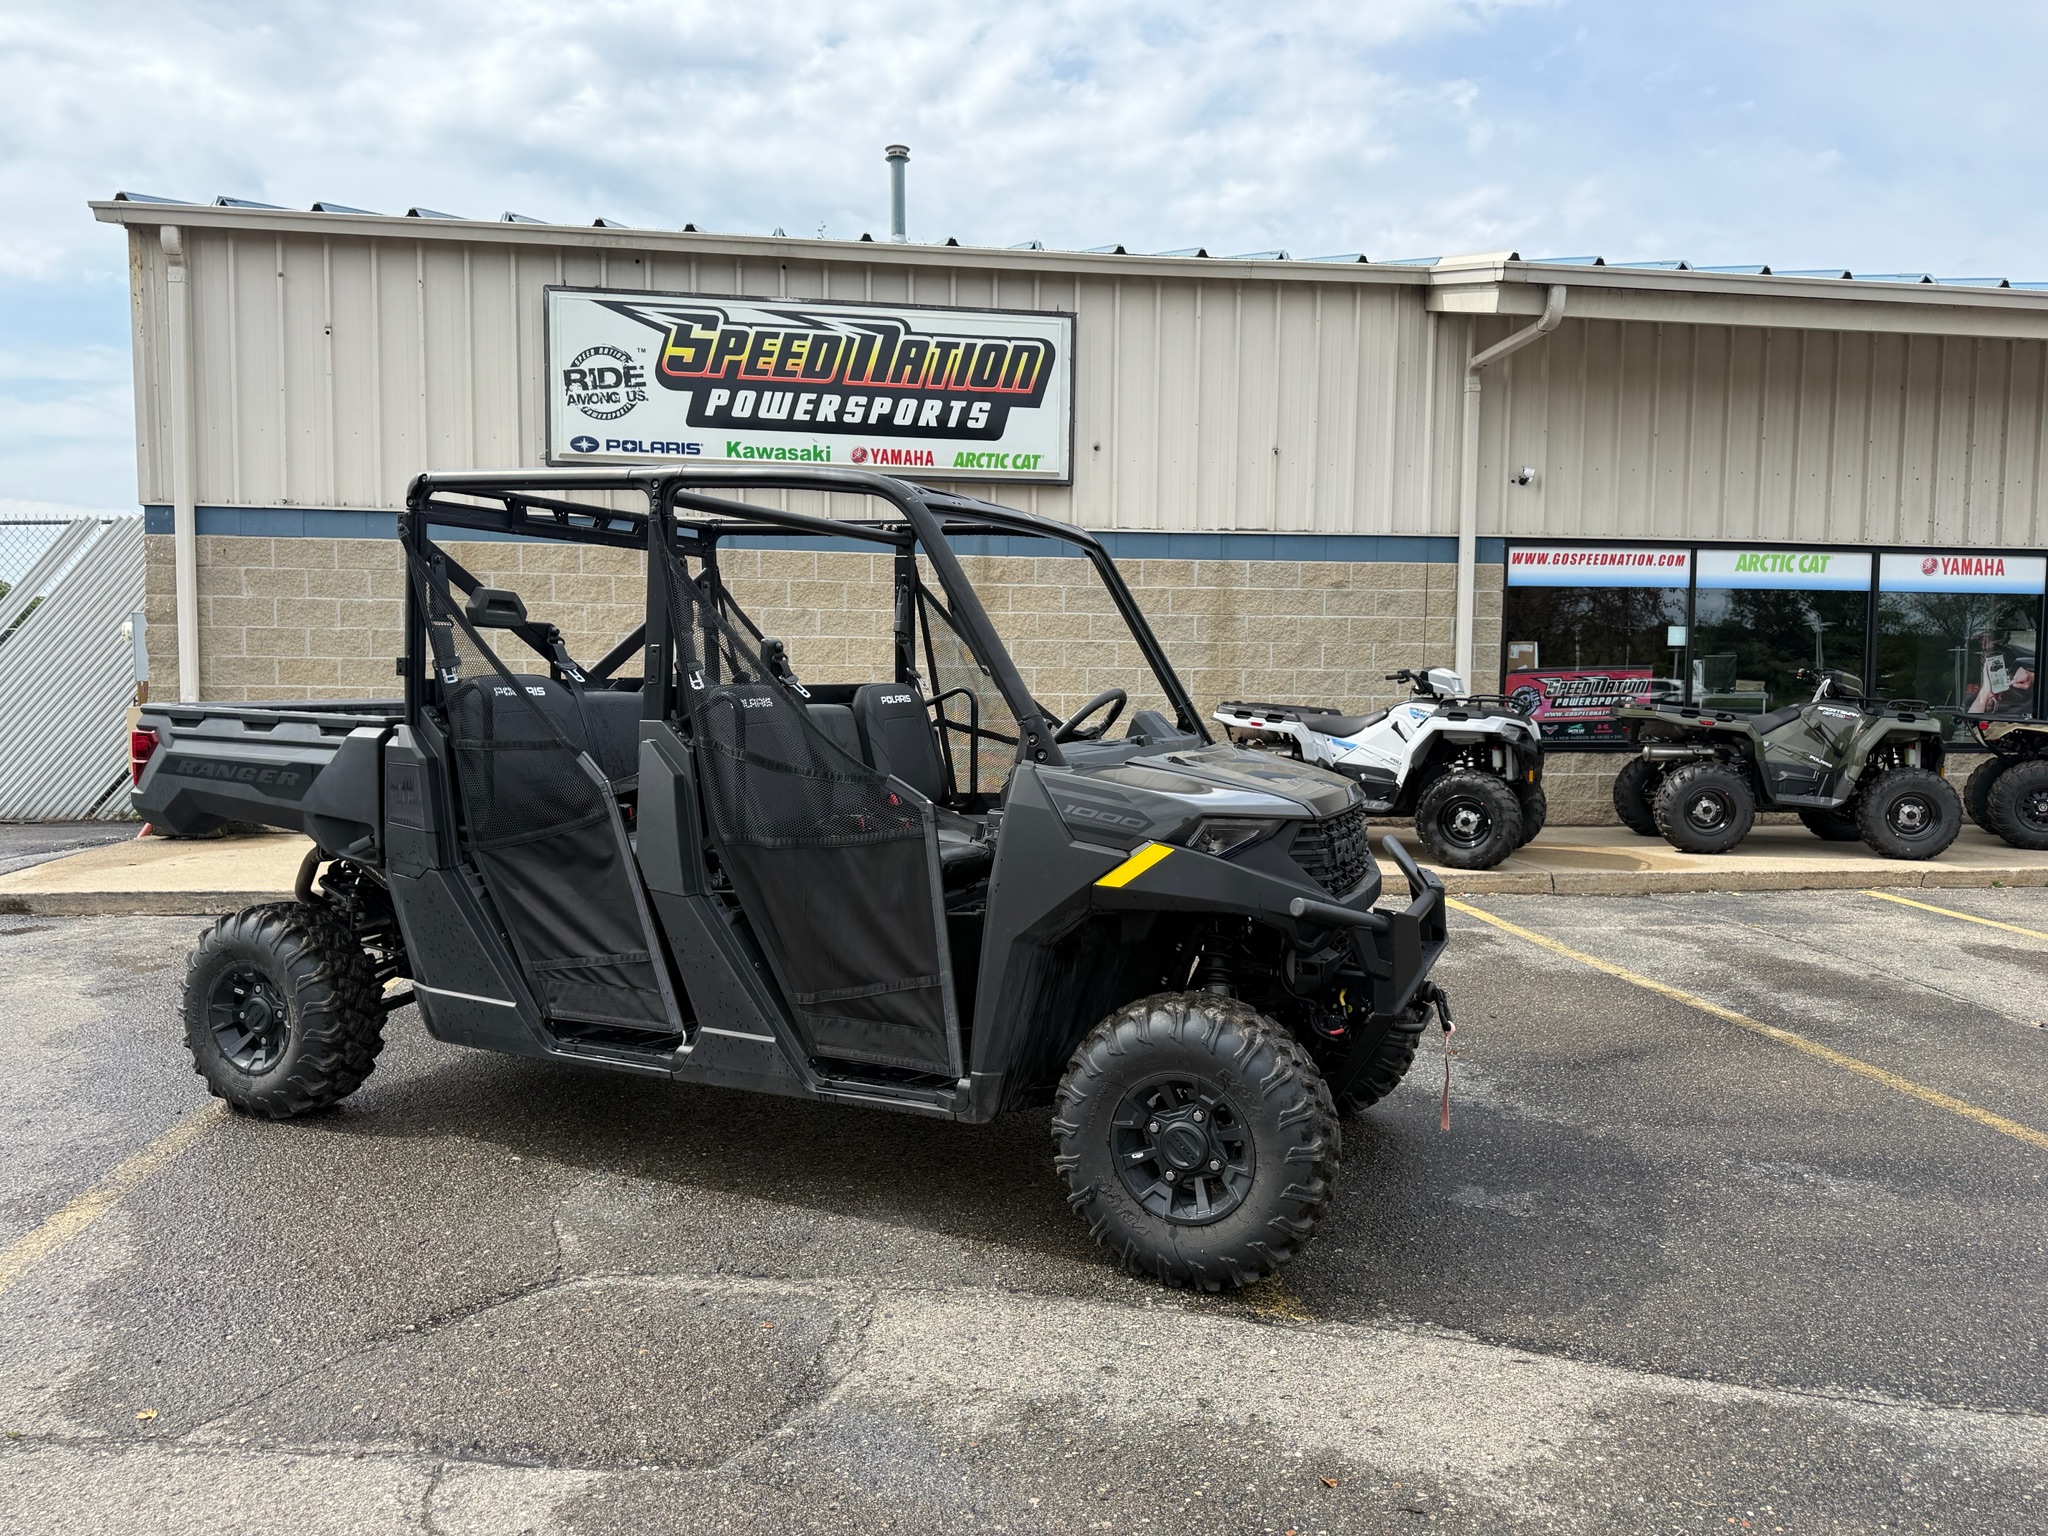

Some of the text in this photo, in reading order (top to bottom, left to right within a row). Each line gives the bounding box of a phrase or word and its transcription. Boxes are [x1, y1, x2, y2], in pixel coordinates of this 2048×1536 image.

[563, 365, 647, 394] RIDE
[567, 391, 621, 407] AMONG
[703, 387, 993, 430] POWERSPORTS
[605, 438, 702, 455] POLARIS
[726, 440, 832, 462] Kawasaki
[870, 447, 935, 467] YAMAHA
[953, 451, 1042, 470] ARCTIC CAT
[1511, 552, 1686, 567] WWW.GOSPEEDNATION.COM
[1734, 553, 1832, 574] ARCTIC CAT
[1941, 557, 2006, 577] YAMAHA
[880, 694, 912, 705] POLARIS
[176, 759, 300, 786] RANGER
[1063, 804, 1148, 829] 1000
